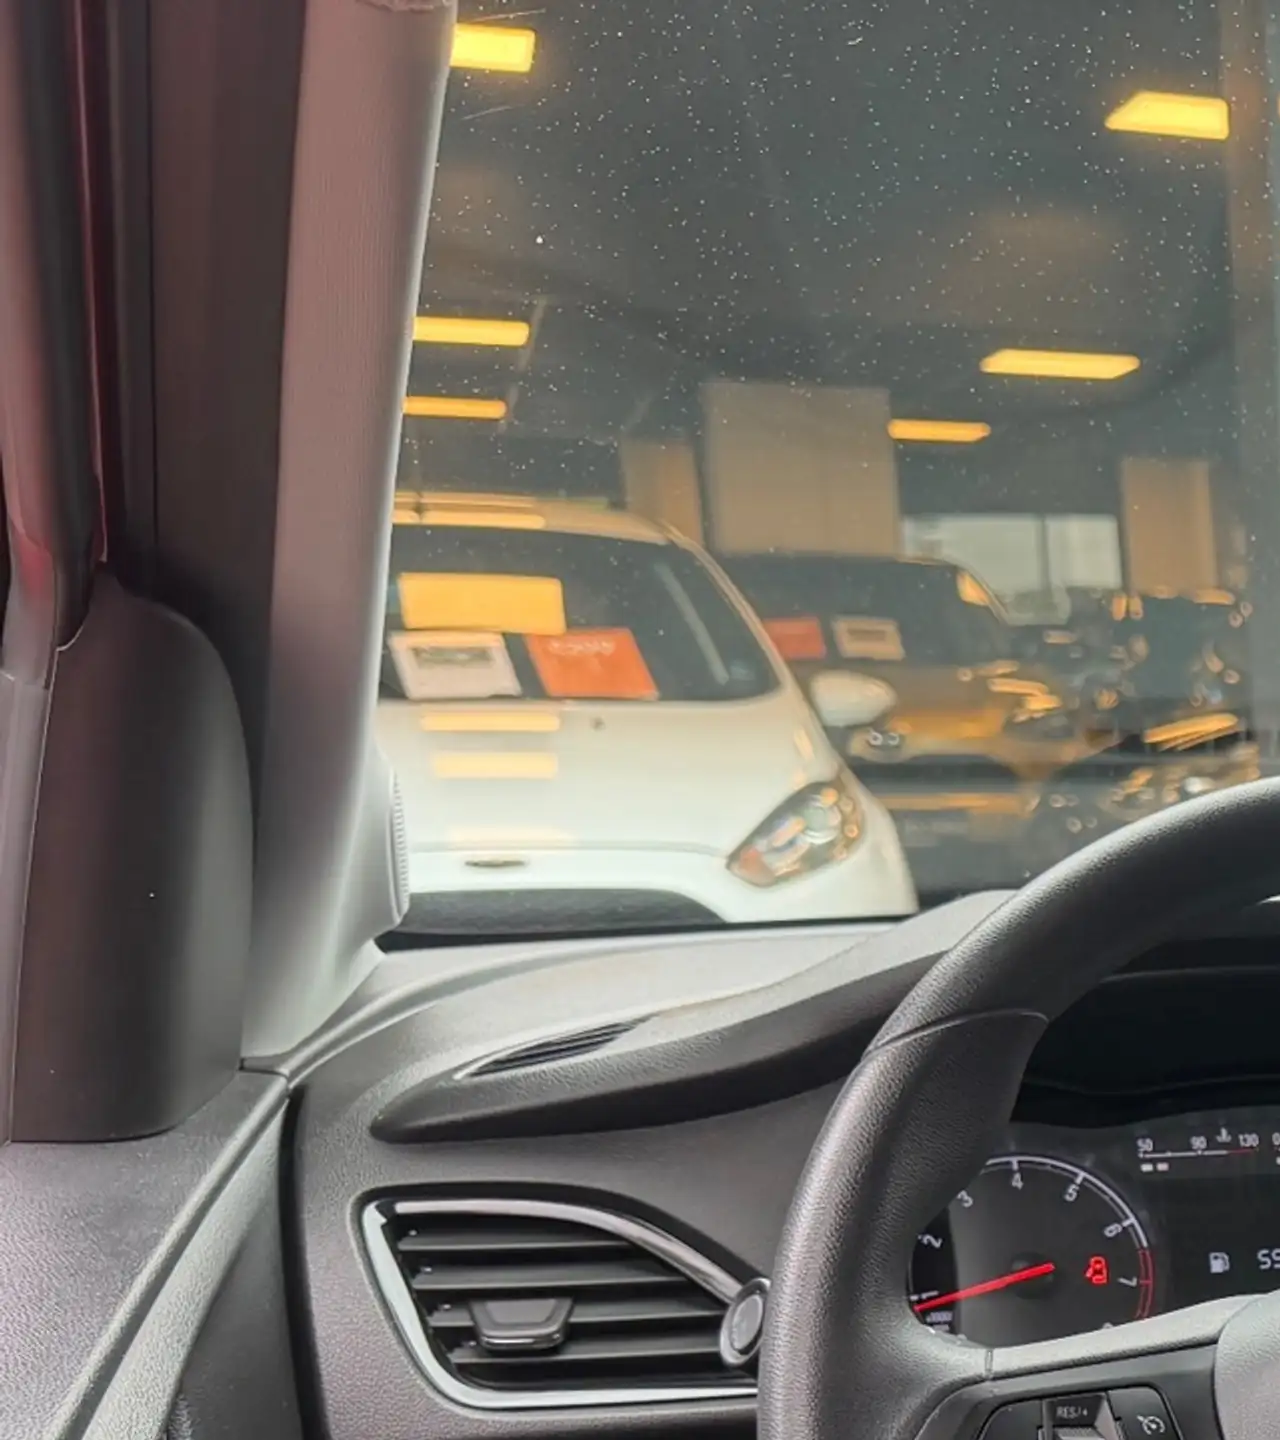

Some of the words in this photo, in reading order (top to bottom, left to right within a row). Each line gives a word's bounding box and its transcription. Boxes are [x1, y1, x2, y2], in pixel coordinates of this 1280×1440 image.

[1137, 1138, 1153, 1151] 50
[1190, 1136, 1207, 1151] 90
[1238, 1133, 1259, 1147] 130
[1011, 1173, 1024, 1190] 4
[957, 1190, 973, 1208] 3
[1063, 1183, 1080, 1202] 5
[1103, 1222, 1122, 1238] 6
[921, 1234, 943, 1249] 2
[1117, 1276, 1138, 1287] 7
